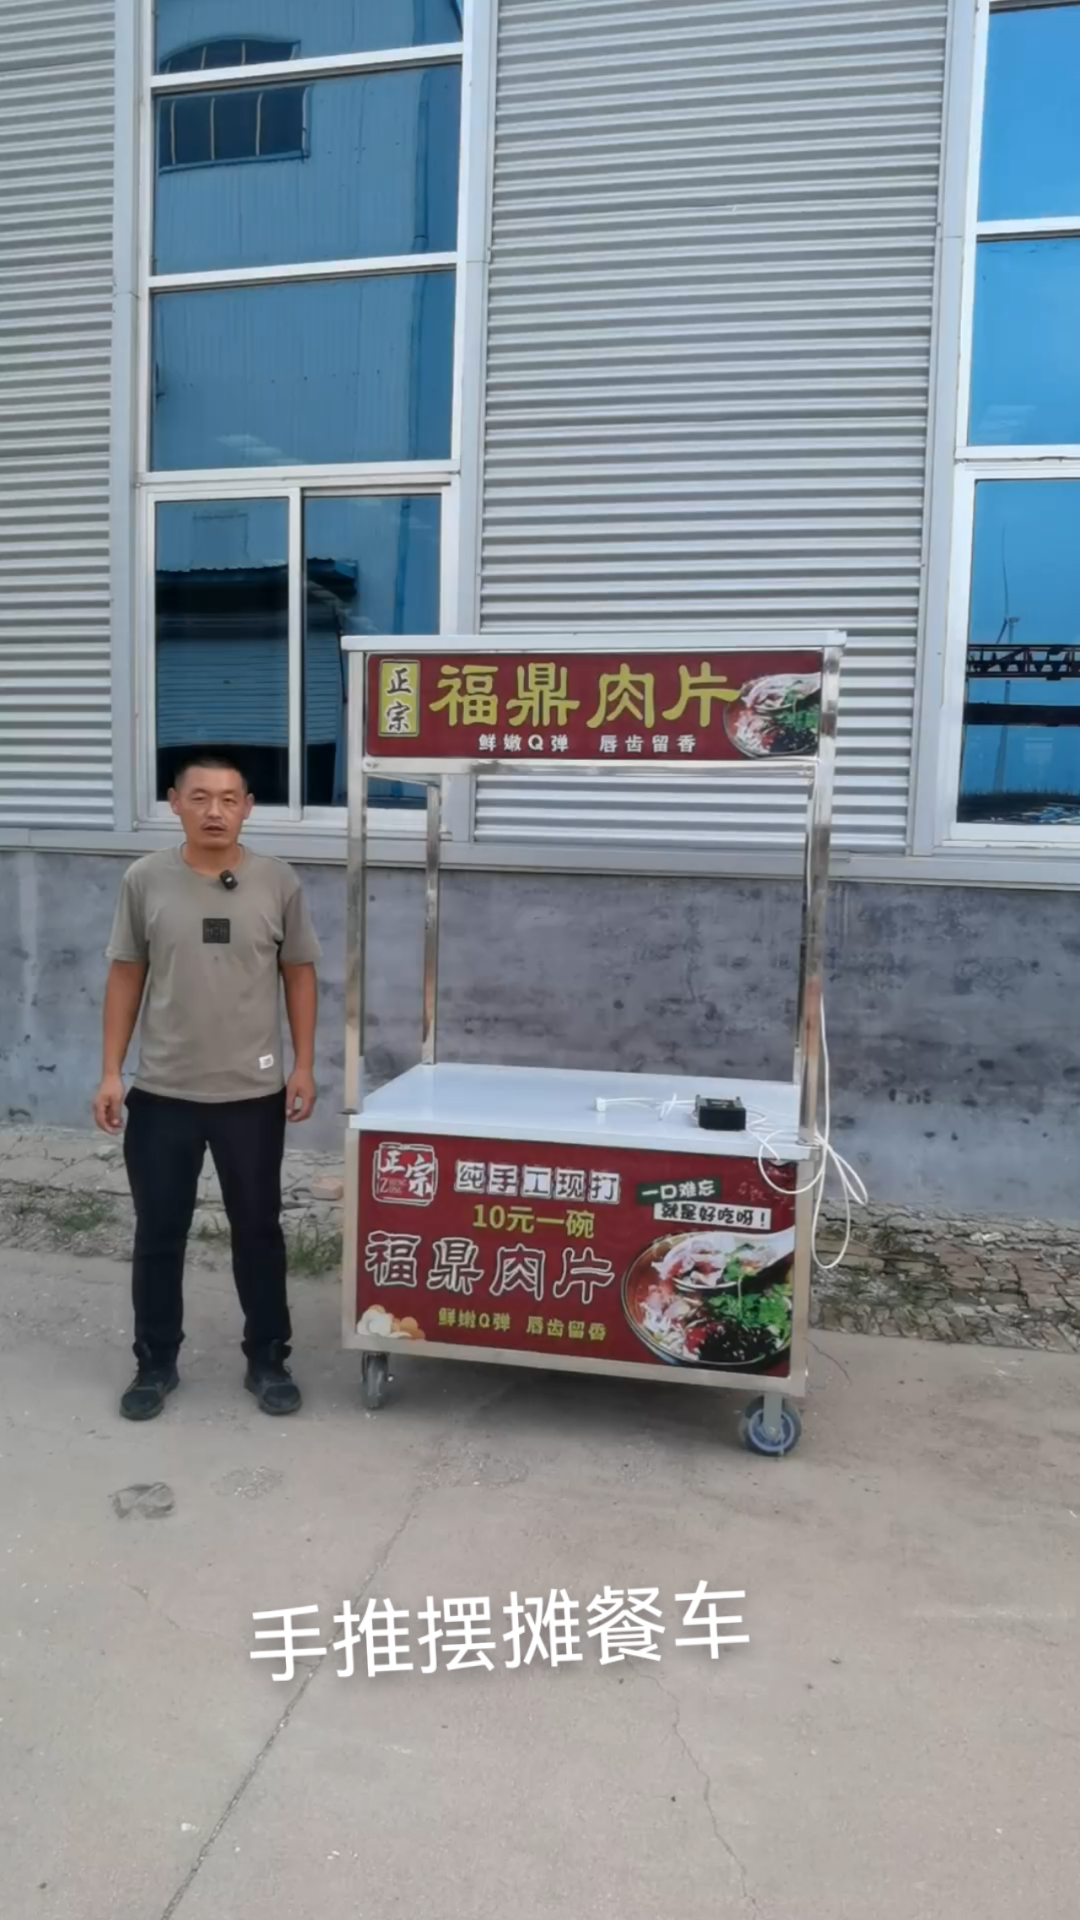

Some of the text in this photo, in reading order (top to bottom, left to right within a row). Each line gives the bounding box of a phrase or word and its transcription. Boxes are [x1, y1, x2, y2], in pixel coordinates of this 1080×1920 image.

[385, 666, 414, 734] 正宗
[429, 661, 741, 729] 福鼎肉片
[479, 734, 696, 753] 鲜嫩Q弹 唇齿留香
[379, 1149, 435, 1198] 正宗
[456, 1161, 619, 1202] 纯手工现打
[641, 1179, 716, 1201] 一口难忘
[473, 1203, 595, 1239] 10元一碗
[365, 1230, 615, 1304] 福鼎肉片
[438, 1307, 607, 1341] 鲜嫩Q弹 唇齿留香
